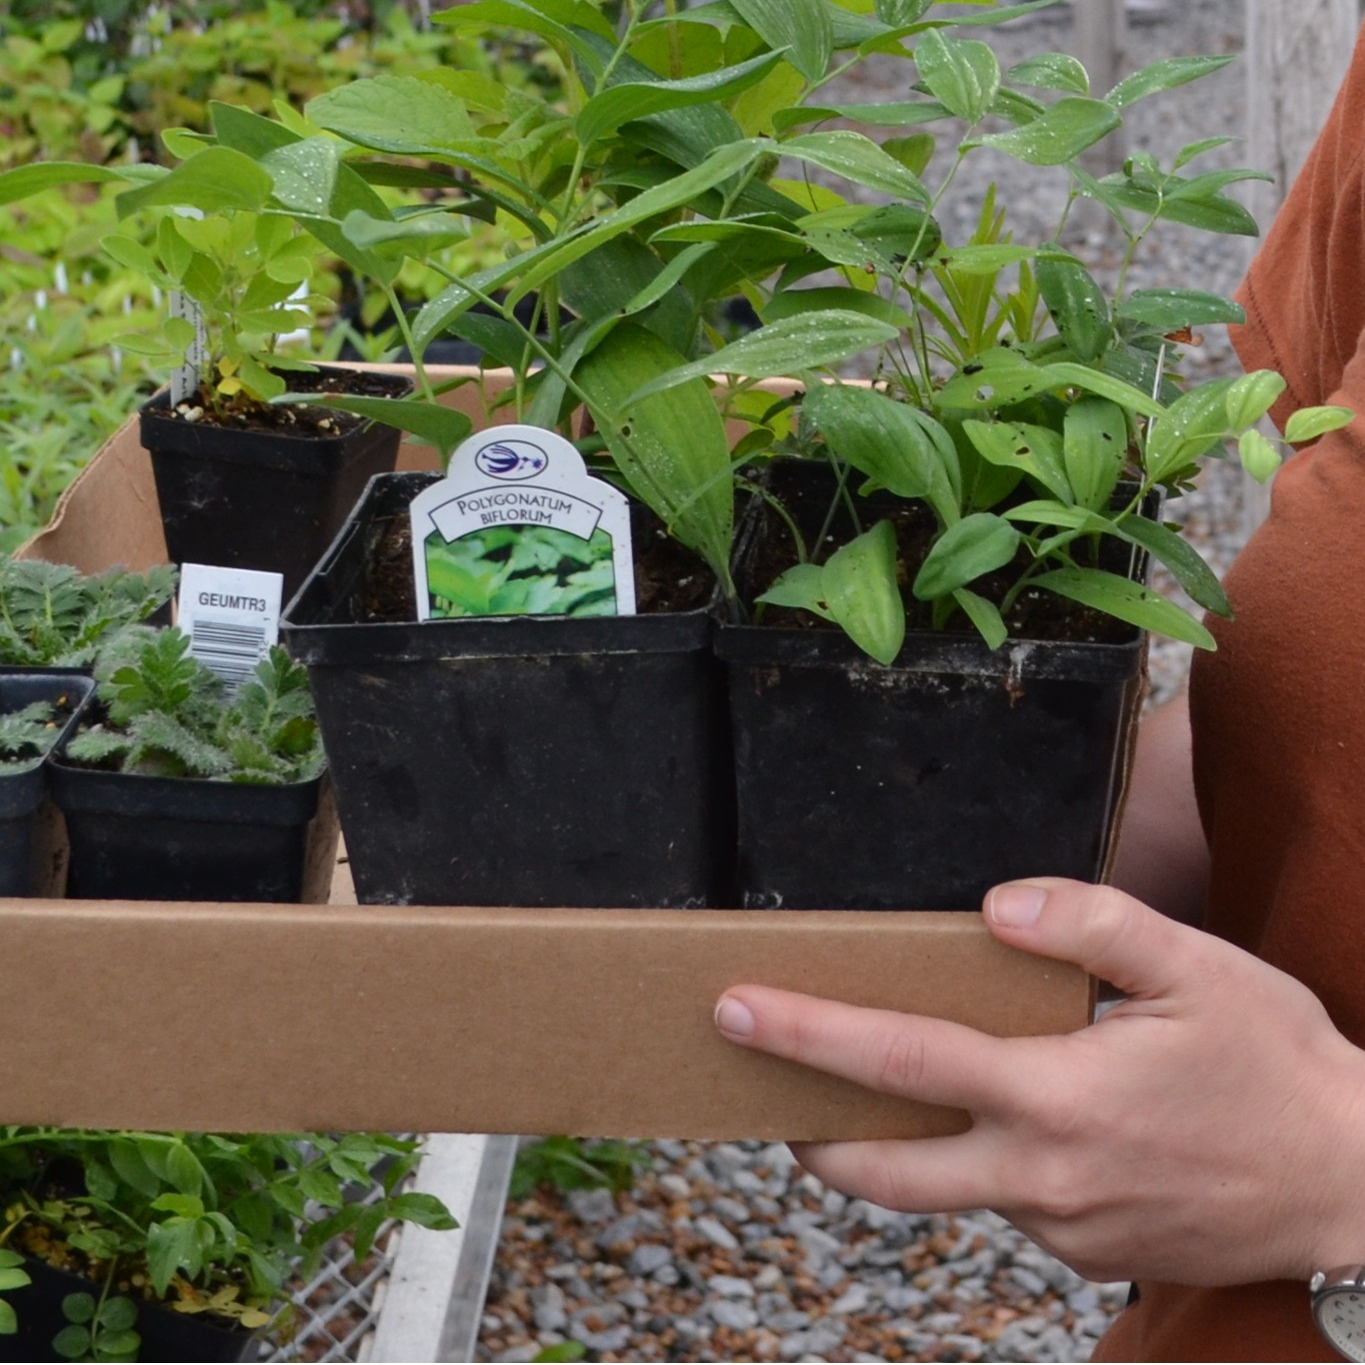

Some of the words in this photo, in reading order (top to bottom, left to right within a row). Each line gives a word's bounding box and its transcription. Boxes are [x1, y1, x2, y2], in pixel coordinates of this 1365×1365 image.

[456, 492, 573, 516] POLYGONATUM
[480, 508, 553, 526] BIFLORUM
[198, 591, 267, 613] GEUMTR3
